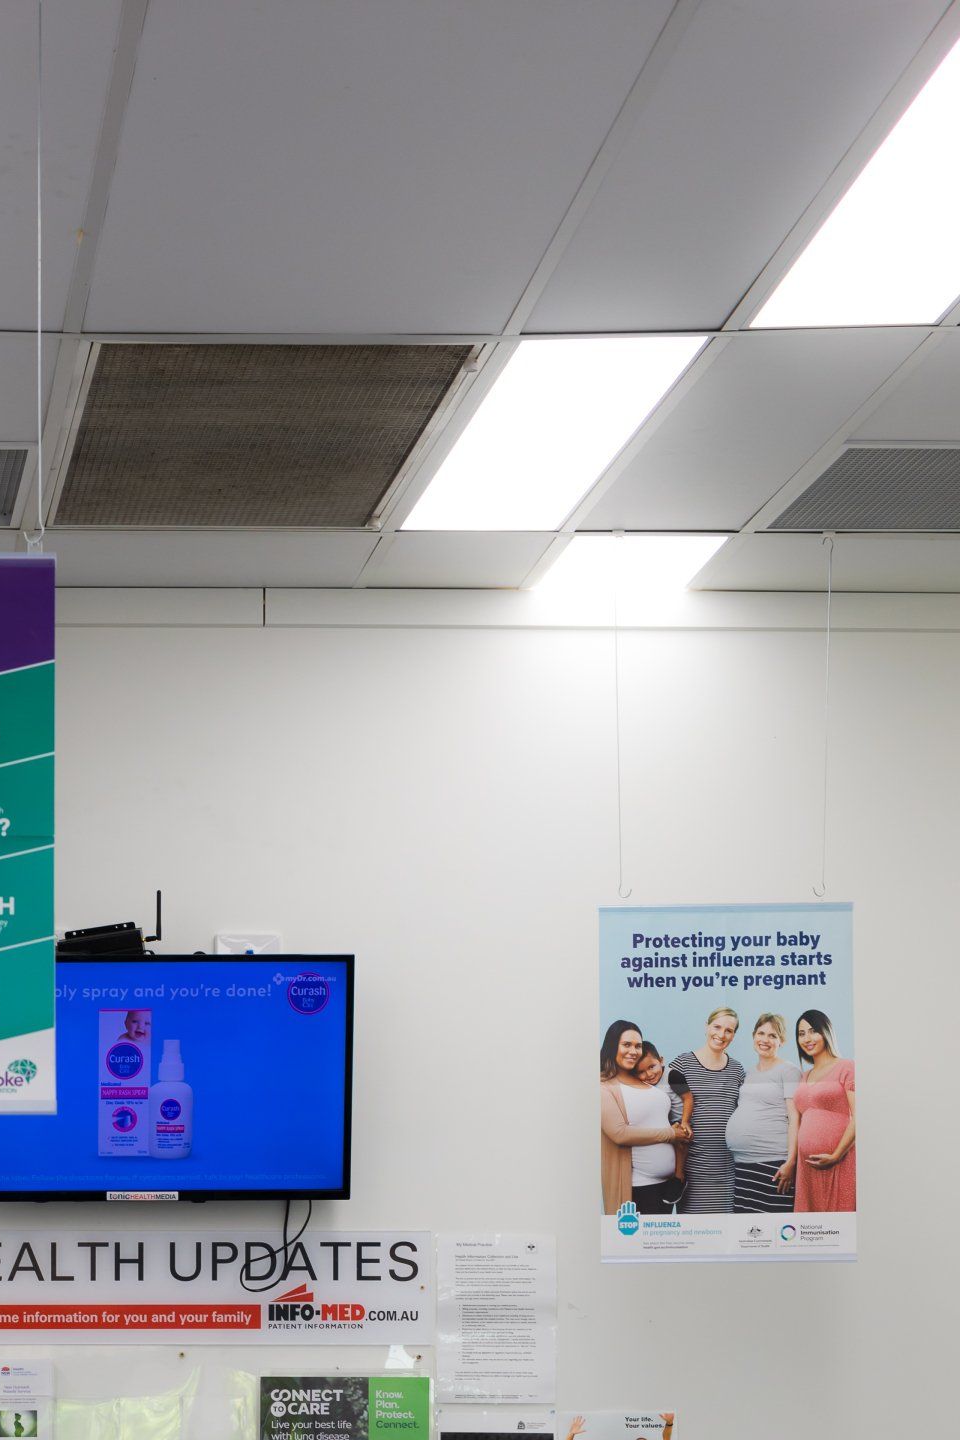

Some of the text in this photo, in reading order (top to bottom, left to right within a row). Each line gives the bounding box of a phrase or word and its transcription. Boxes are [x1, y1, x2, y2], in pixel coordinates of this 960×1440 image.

[632, 931, 820, 951] Protecting your baby
[620, 951, 832, 972] against influenza starts
[627, 971, 826, 991] when you’re pregnant
[55, 985, 271, 1000] ply spray and you're done!
[291, 987, 325, 995] Curash
[110, 1192, 176, 1200] tonicHEALTHMEDIA
[169, 1242, 418, 1282] UPDATES
[23, 1310, 98, 1323] information
[102, 1311, 120, 1323] for
[124, 1313, 148, 1326] you
[152, 1311, 176, 1323] and
[180, 1313, 207, 1326] your
[211, 1311, 251, 1326] family
[271, 1389, 343, 1401] CONNECT
[376, 1390, 403, 1398] Know.
[287, 1403, 329, 1415] CARE
[272, 1421, 352, 1431] Live your best life
[376, 1421, 419, 1429] Connect.
[271, 1432, 292, 1440] with
[316, 1432, 349, 1440] disease
